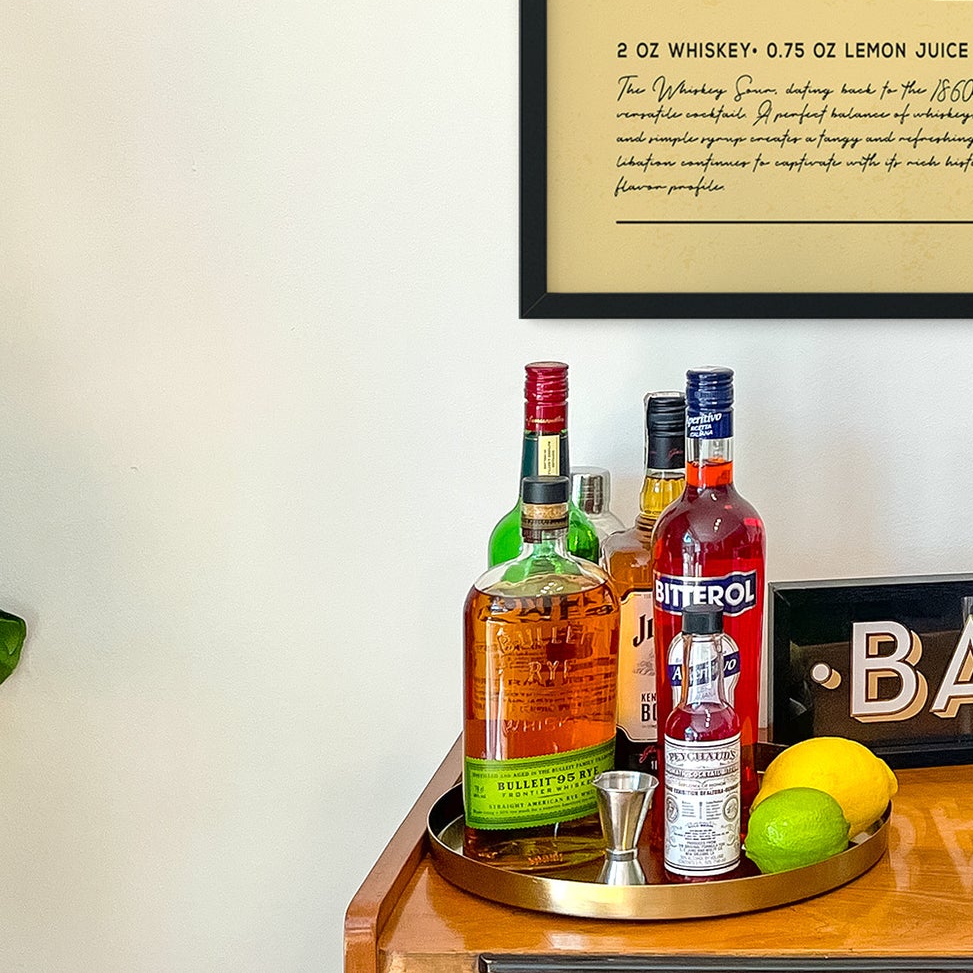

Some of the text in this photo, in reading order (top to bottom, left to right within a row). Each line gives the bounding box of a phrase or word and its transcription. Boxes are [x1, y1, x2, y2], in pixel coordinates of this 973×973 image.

[617, 42, 628, 59] 2
[636, 42, 659, 59] OZ
[766, 42, 805, 59] 0.75
[813, 42, 836, 59] OZ
[845, 42, 906, 59] LEMON
[915, 42, 969, 59] JUICE
[617, 75, 646, 101] The
[652, 76, 728, 102] Whiskey
[786, 81, 834, 100] dating
[841, 83, 877, 95] back
[880, 81, 898, 100] to
[901, 81, 928, 100] the
[617, 105, 683, 124] versatile
[753, 100, 774, 126] A
[773, 104, 828, 125] perfect
[831, 108, 890, 119] balance
[894, 104, 910, 124] of
[616, 131, 646, 143] and
[649, 131, 700, 147] simple
[700, 136, 747, 148] syrup
[750, 129, 802, 148] creates
[817, 129, 863, 149] tangy
[866, 131, 896, 143] and
[616, 153, 677, 173] libation
[681, 153, 751, 172] continues
[753, 153, 770, 172] to
[775, 153, 842, 173] captivate
[847, 153, 881, 173] with
[885, 153, 902, 173] its
[907, 156, 941, 167] rich
[614, 176, 668, 197] flavor
[655, 579, 755, 608] BITTEROL
[498, 766, 599, 791] BULLEIT 95 RYE
[556, 779, 592, 791] WHISKE
